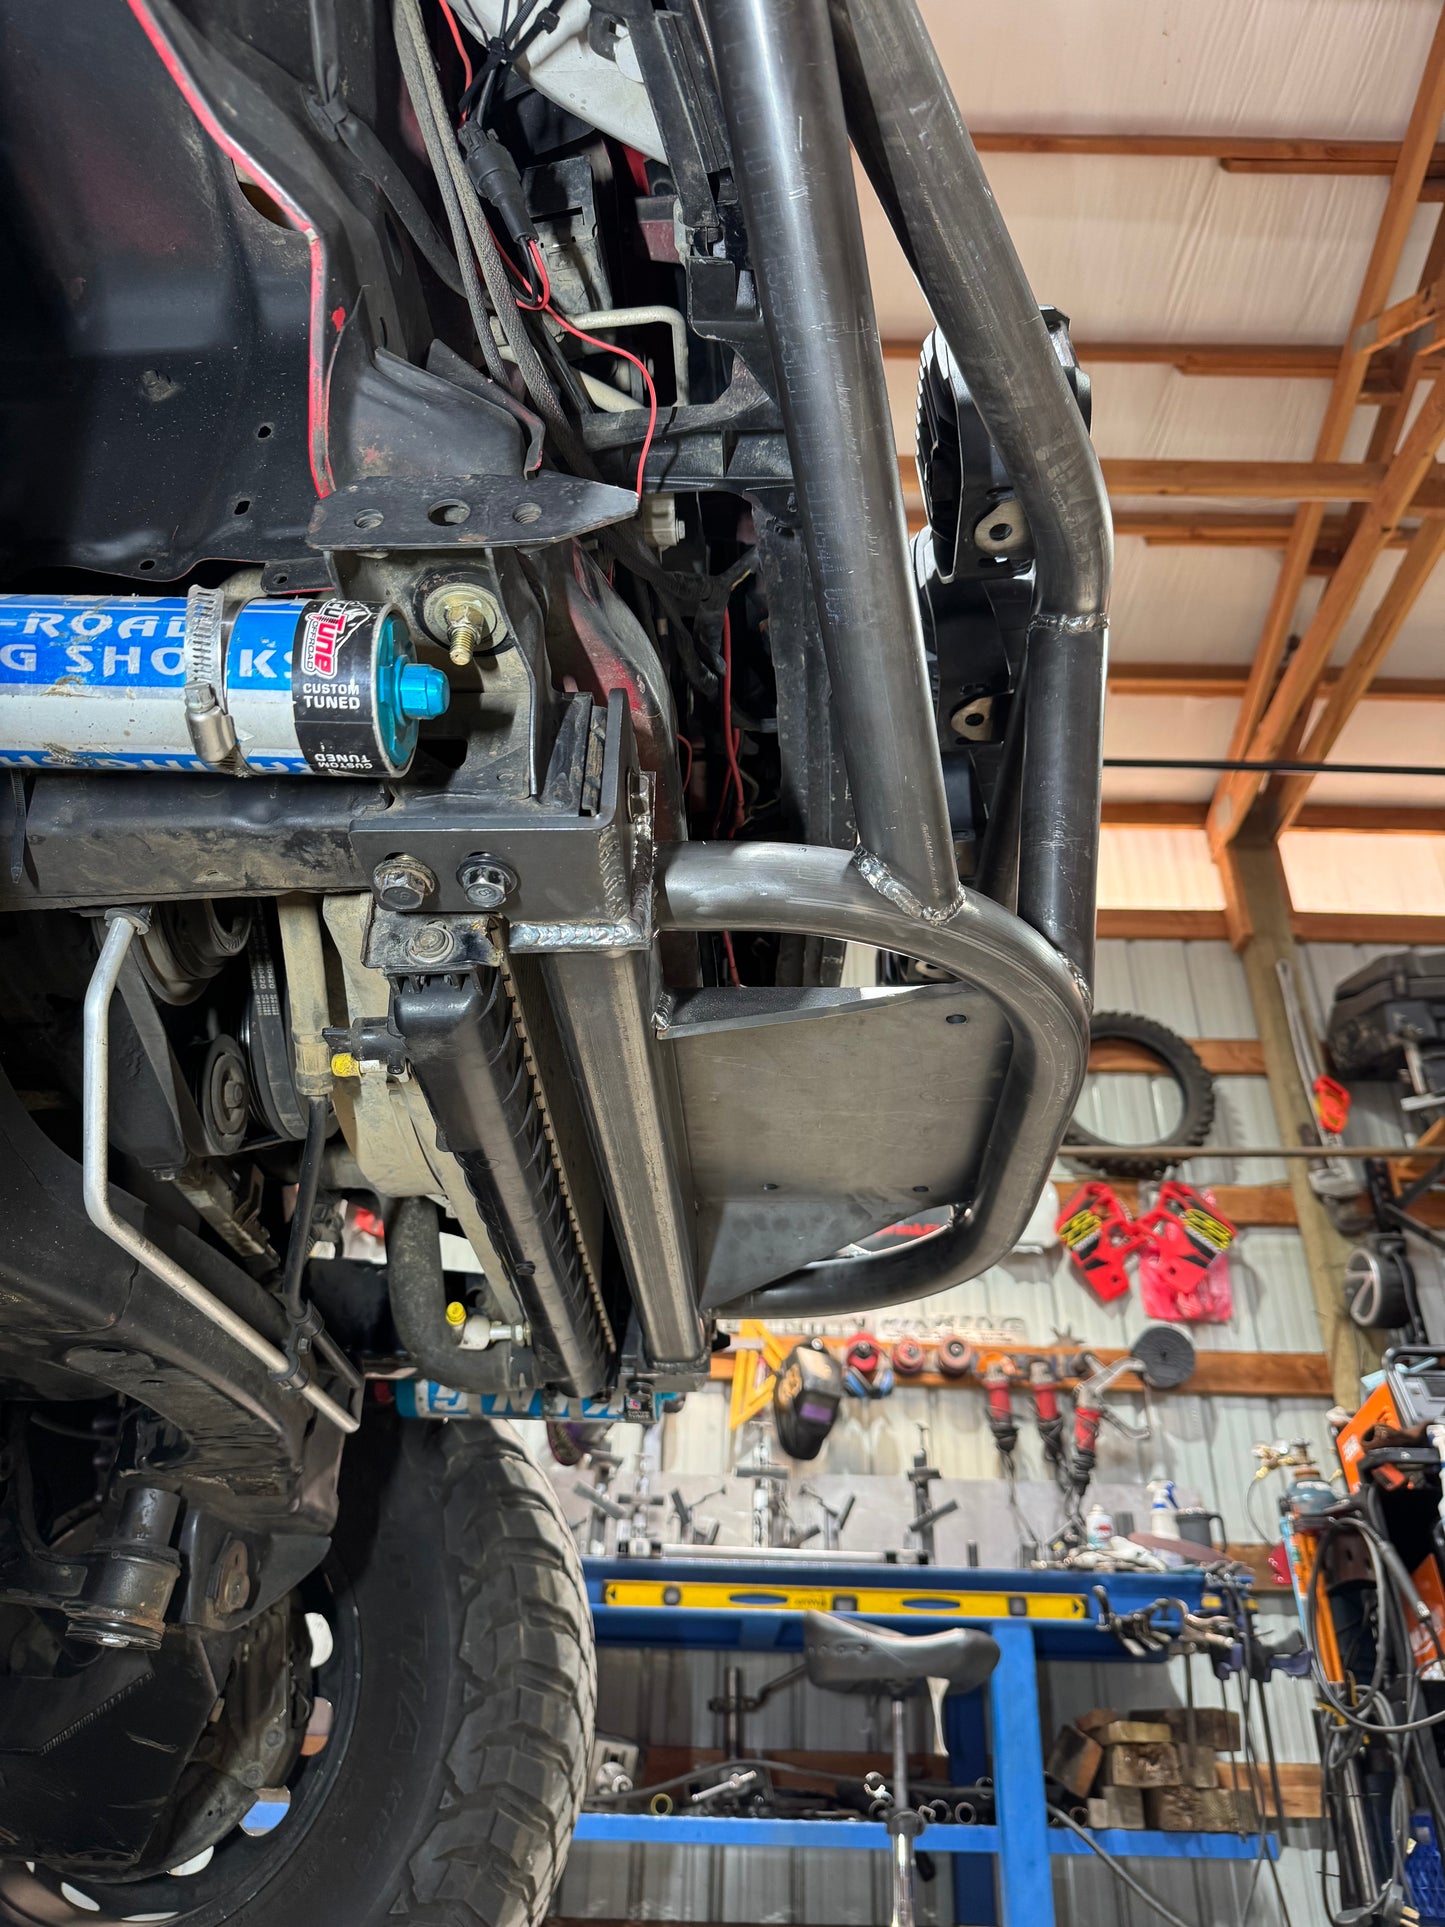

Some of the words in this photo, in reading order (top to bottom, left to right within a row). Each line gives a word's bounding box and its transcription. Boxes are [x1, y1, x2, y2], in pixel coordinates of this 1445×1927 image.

[307, 620, 319, 670] OFFROAD
[65, 645, 292, 678] SHOK
[303, 683, 360, 695] CUSTOM
[303, 695, 361, 710] TUNED
[314, 753, 371, 763] TUNED
[318, 761, 373, 770] CUSTOM
